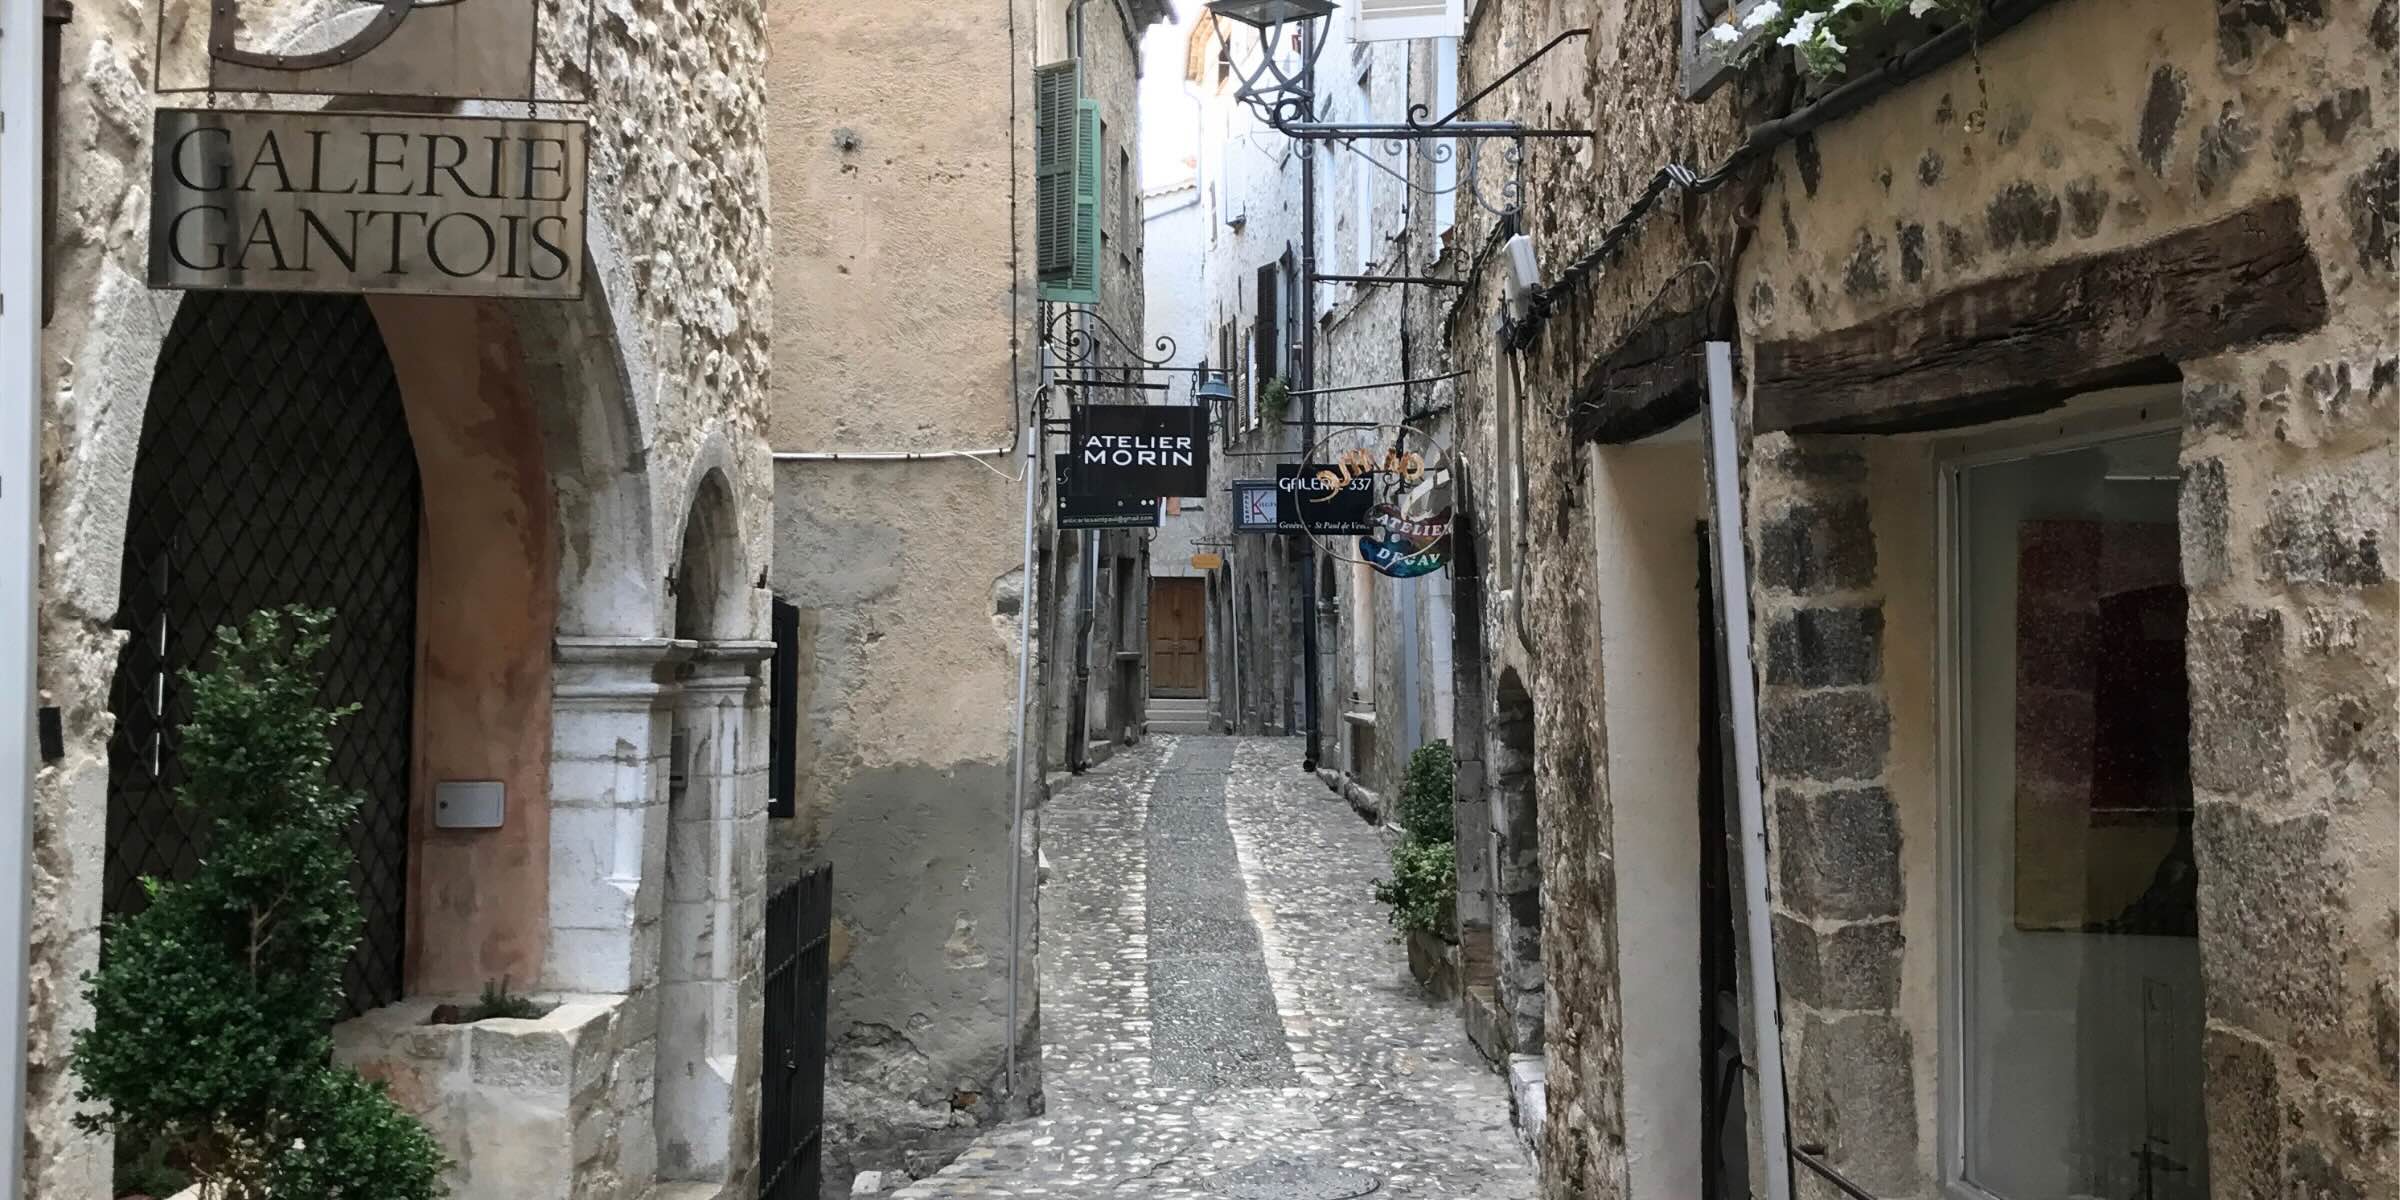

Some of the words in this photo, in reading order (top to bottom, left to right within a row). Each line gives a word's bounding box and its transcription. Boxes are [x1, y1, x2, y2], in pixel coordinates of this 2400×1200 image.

[171, 126, 572, 201] GALERIE
[168, 204, 571, 281] GANTOIS
[1086, 435, 1191, 449] ATELIER
[1084, 449, 1193, 466] MORIN
[1349, 478, 1372, 491] 337
